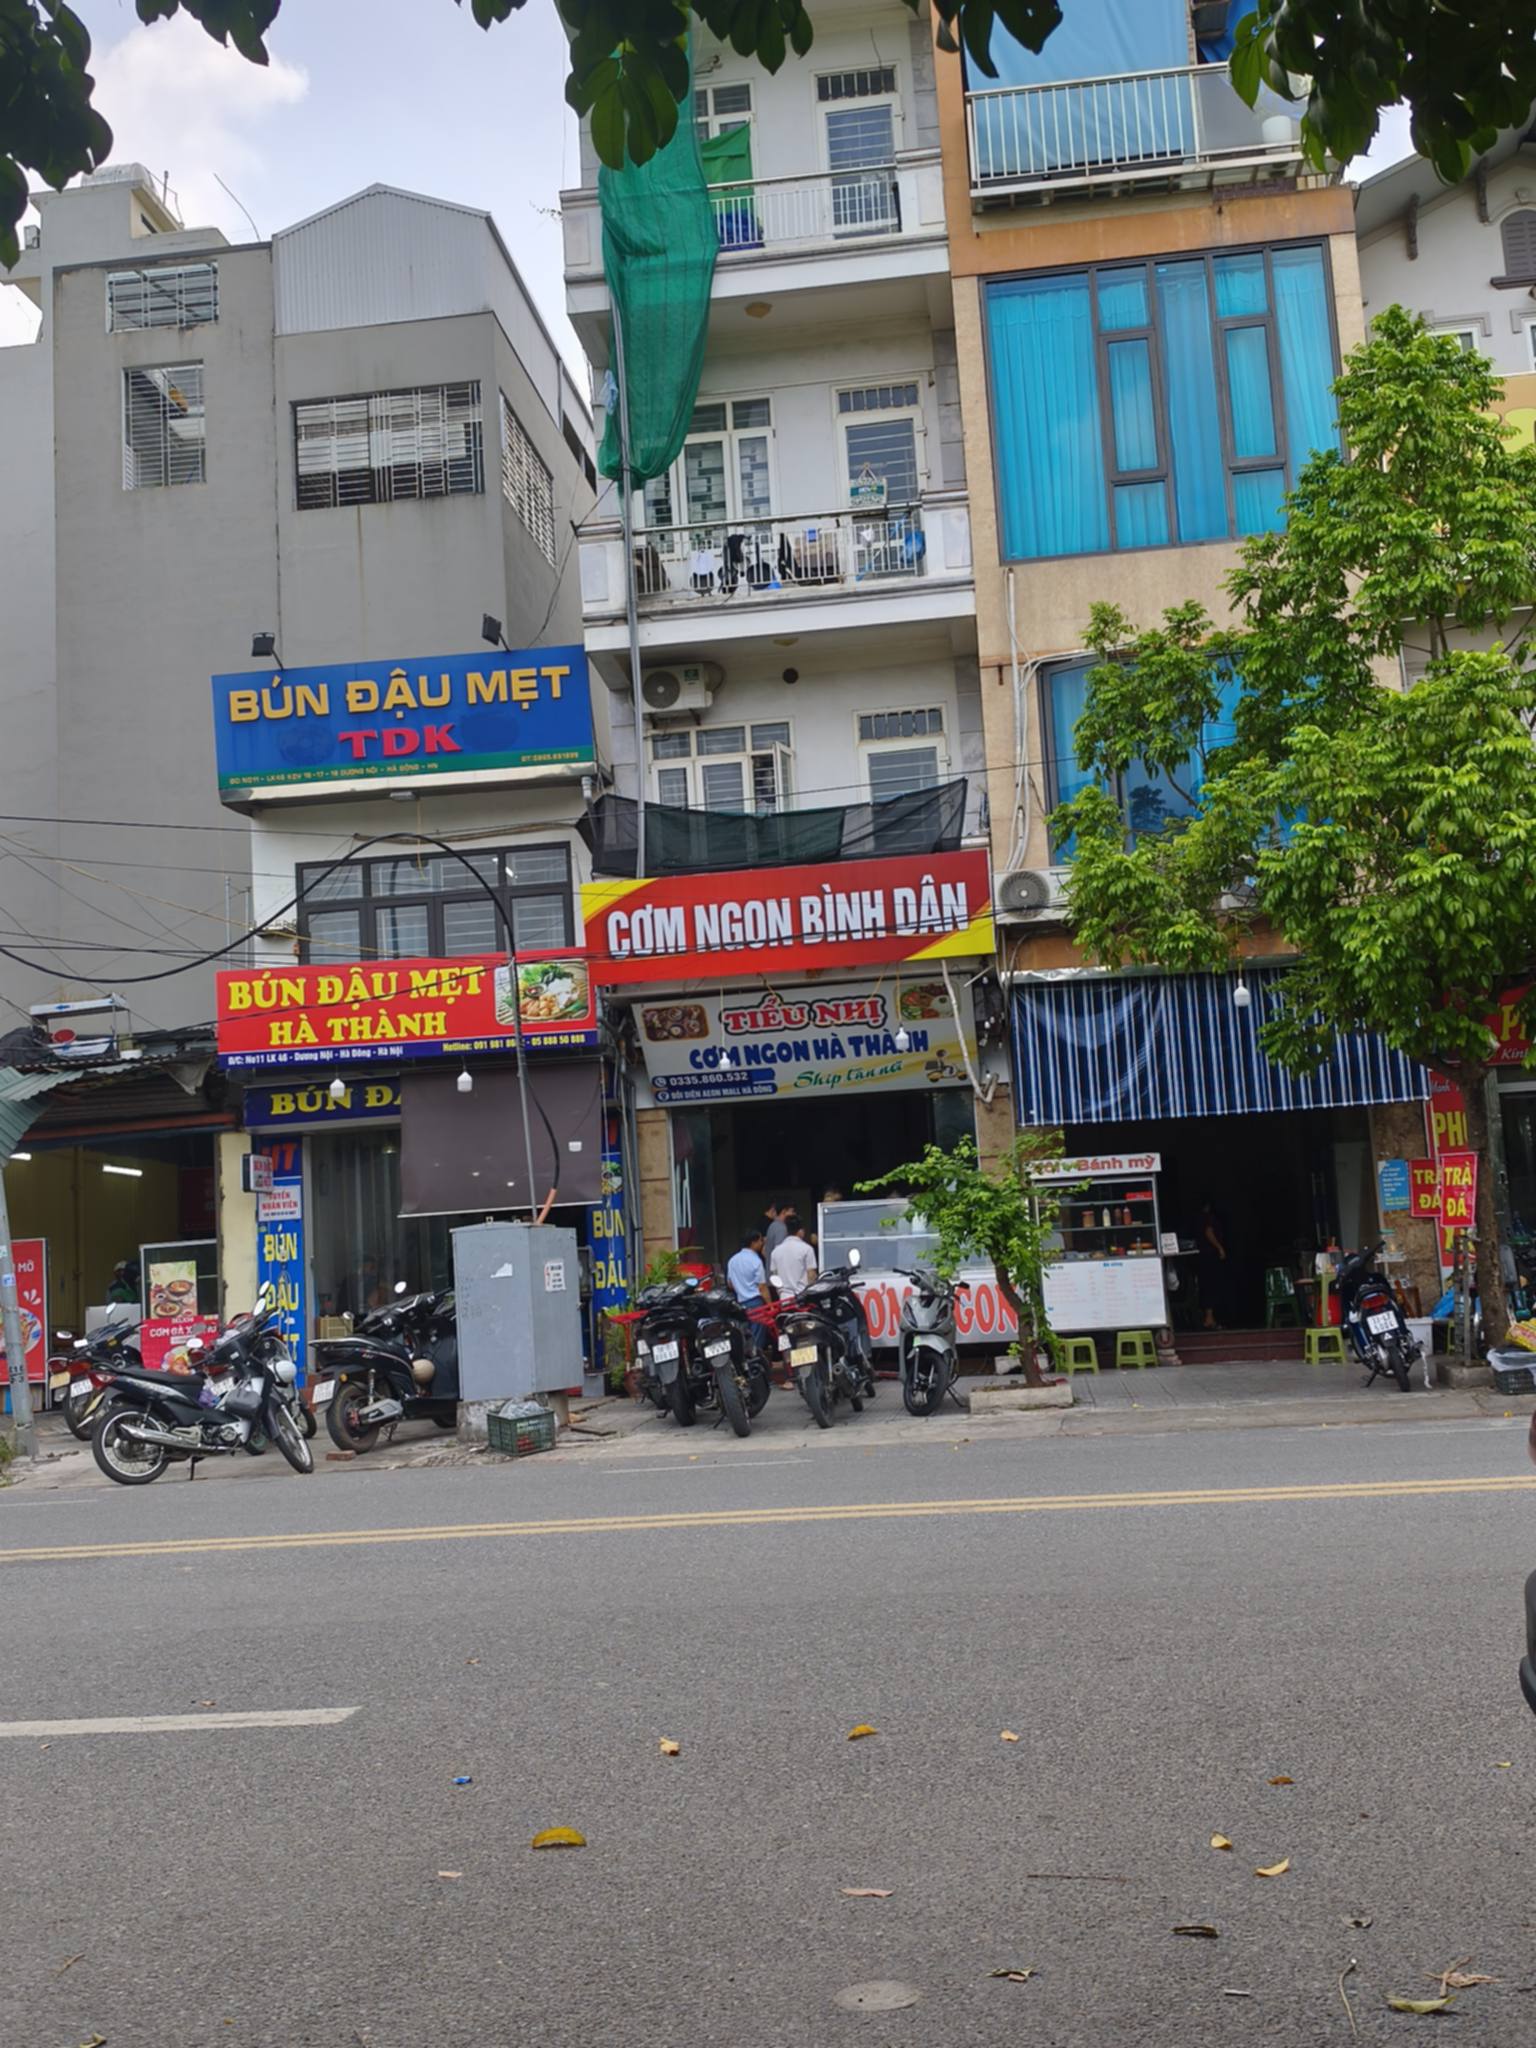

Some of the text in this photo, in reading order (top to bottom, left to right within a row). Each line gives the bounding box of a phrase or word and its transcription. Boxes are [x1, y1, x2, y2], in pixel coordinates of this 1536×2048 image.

[229, 665, 571, 723] BÚN ĐẬU MẸT
[338, 723, 462, 760] TDK
[606, 873, 969, 960] CƠM NGON BÌNH DÂN
[228, 965, 487, 1011] BÚN ĐẬU MẸT
[269, 1008, 447, 1046] HÀ THÀNH
[723, 993, 883, 1032] TIỂU NHỊ
[689, 1028, 929, 1070] CƠM NGON HÀ THÀH
[793, 1070, 842, 1090] Ship
[270, 1084, 353, 1116] BÚN
[1433, 1110, 1468, 1148] PH
[1076, 1157, 1123, 1171] Bánh
[1444, 1160, 1473, 1186] TRÀ
[593, 1199, 625, 1238] BÚN
[1446, 1191, 1468, 1217] ĐÁ
[264, 1223, 298, 1262] BÚN
[854, 1281, 913, 1340] ƠM
[952, 1282, 1019, 1336] GON
